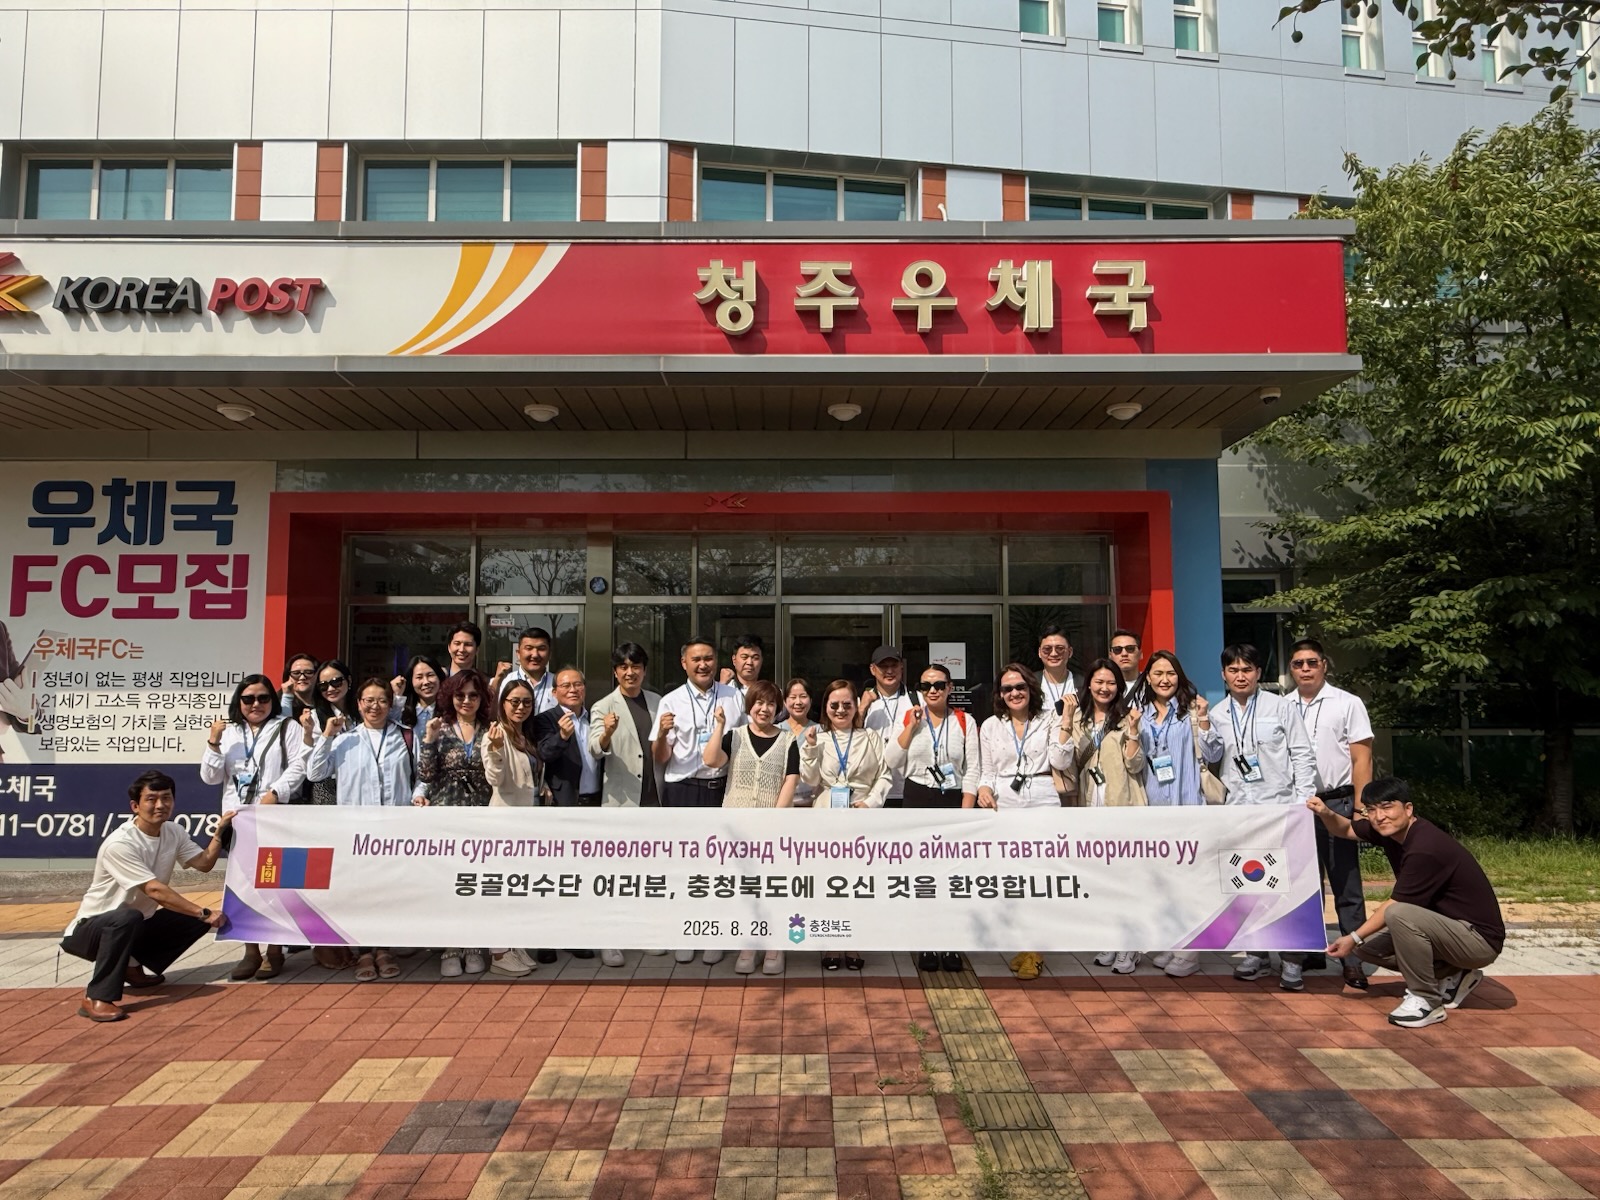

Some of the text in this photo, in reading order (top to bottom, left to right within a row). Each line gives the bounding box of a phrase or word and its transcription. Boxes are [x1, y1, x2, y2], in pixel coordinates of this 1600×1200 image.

[52, 276, 325, 315] KOREA POST
[693, 258, 1155, 336] 청주우체국
[27, 477, 239, 546] 우체국
[9, 554, 250, 620] FC모집
[33, 637, 144, 661] 우체국FC는
[43, 671, 89, 688] 정년이
[95, 671, 126, 688] 없는
[132, 671, 163, 688] 평생
[41, 693, 90, 709] 21세기
[95, 693, 141, 709] 고소득
[40, 714, 117, 731] 생명보험의
[122, 714, 168, 731] 가치를
[38, 736, 186, 752] 보람있는 직업입니다.
[352, 834, 1199, 865] Монголын сургалтын төлөөлөгч та бүхэнд Чүнчонбукдо аймагт тавтай морилно уу
[455, 873, 1090, 900] 몽골연수단 여러분, 충청북도에 오신 것을 환영합니다.
[683, 920, 772, 936] 2025. 8. 28.
[809, 919, 852, 933] 충청북도
